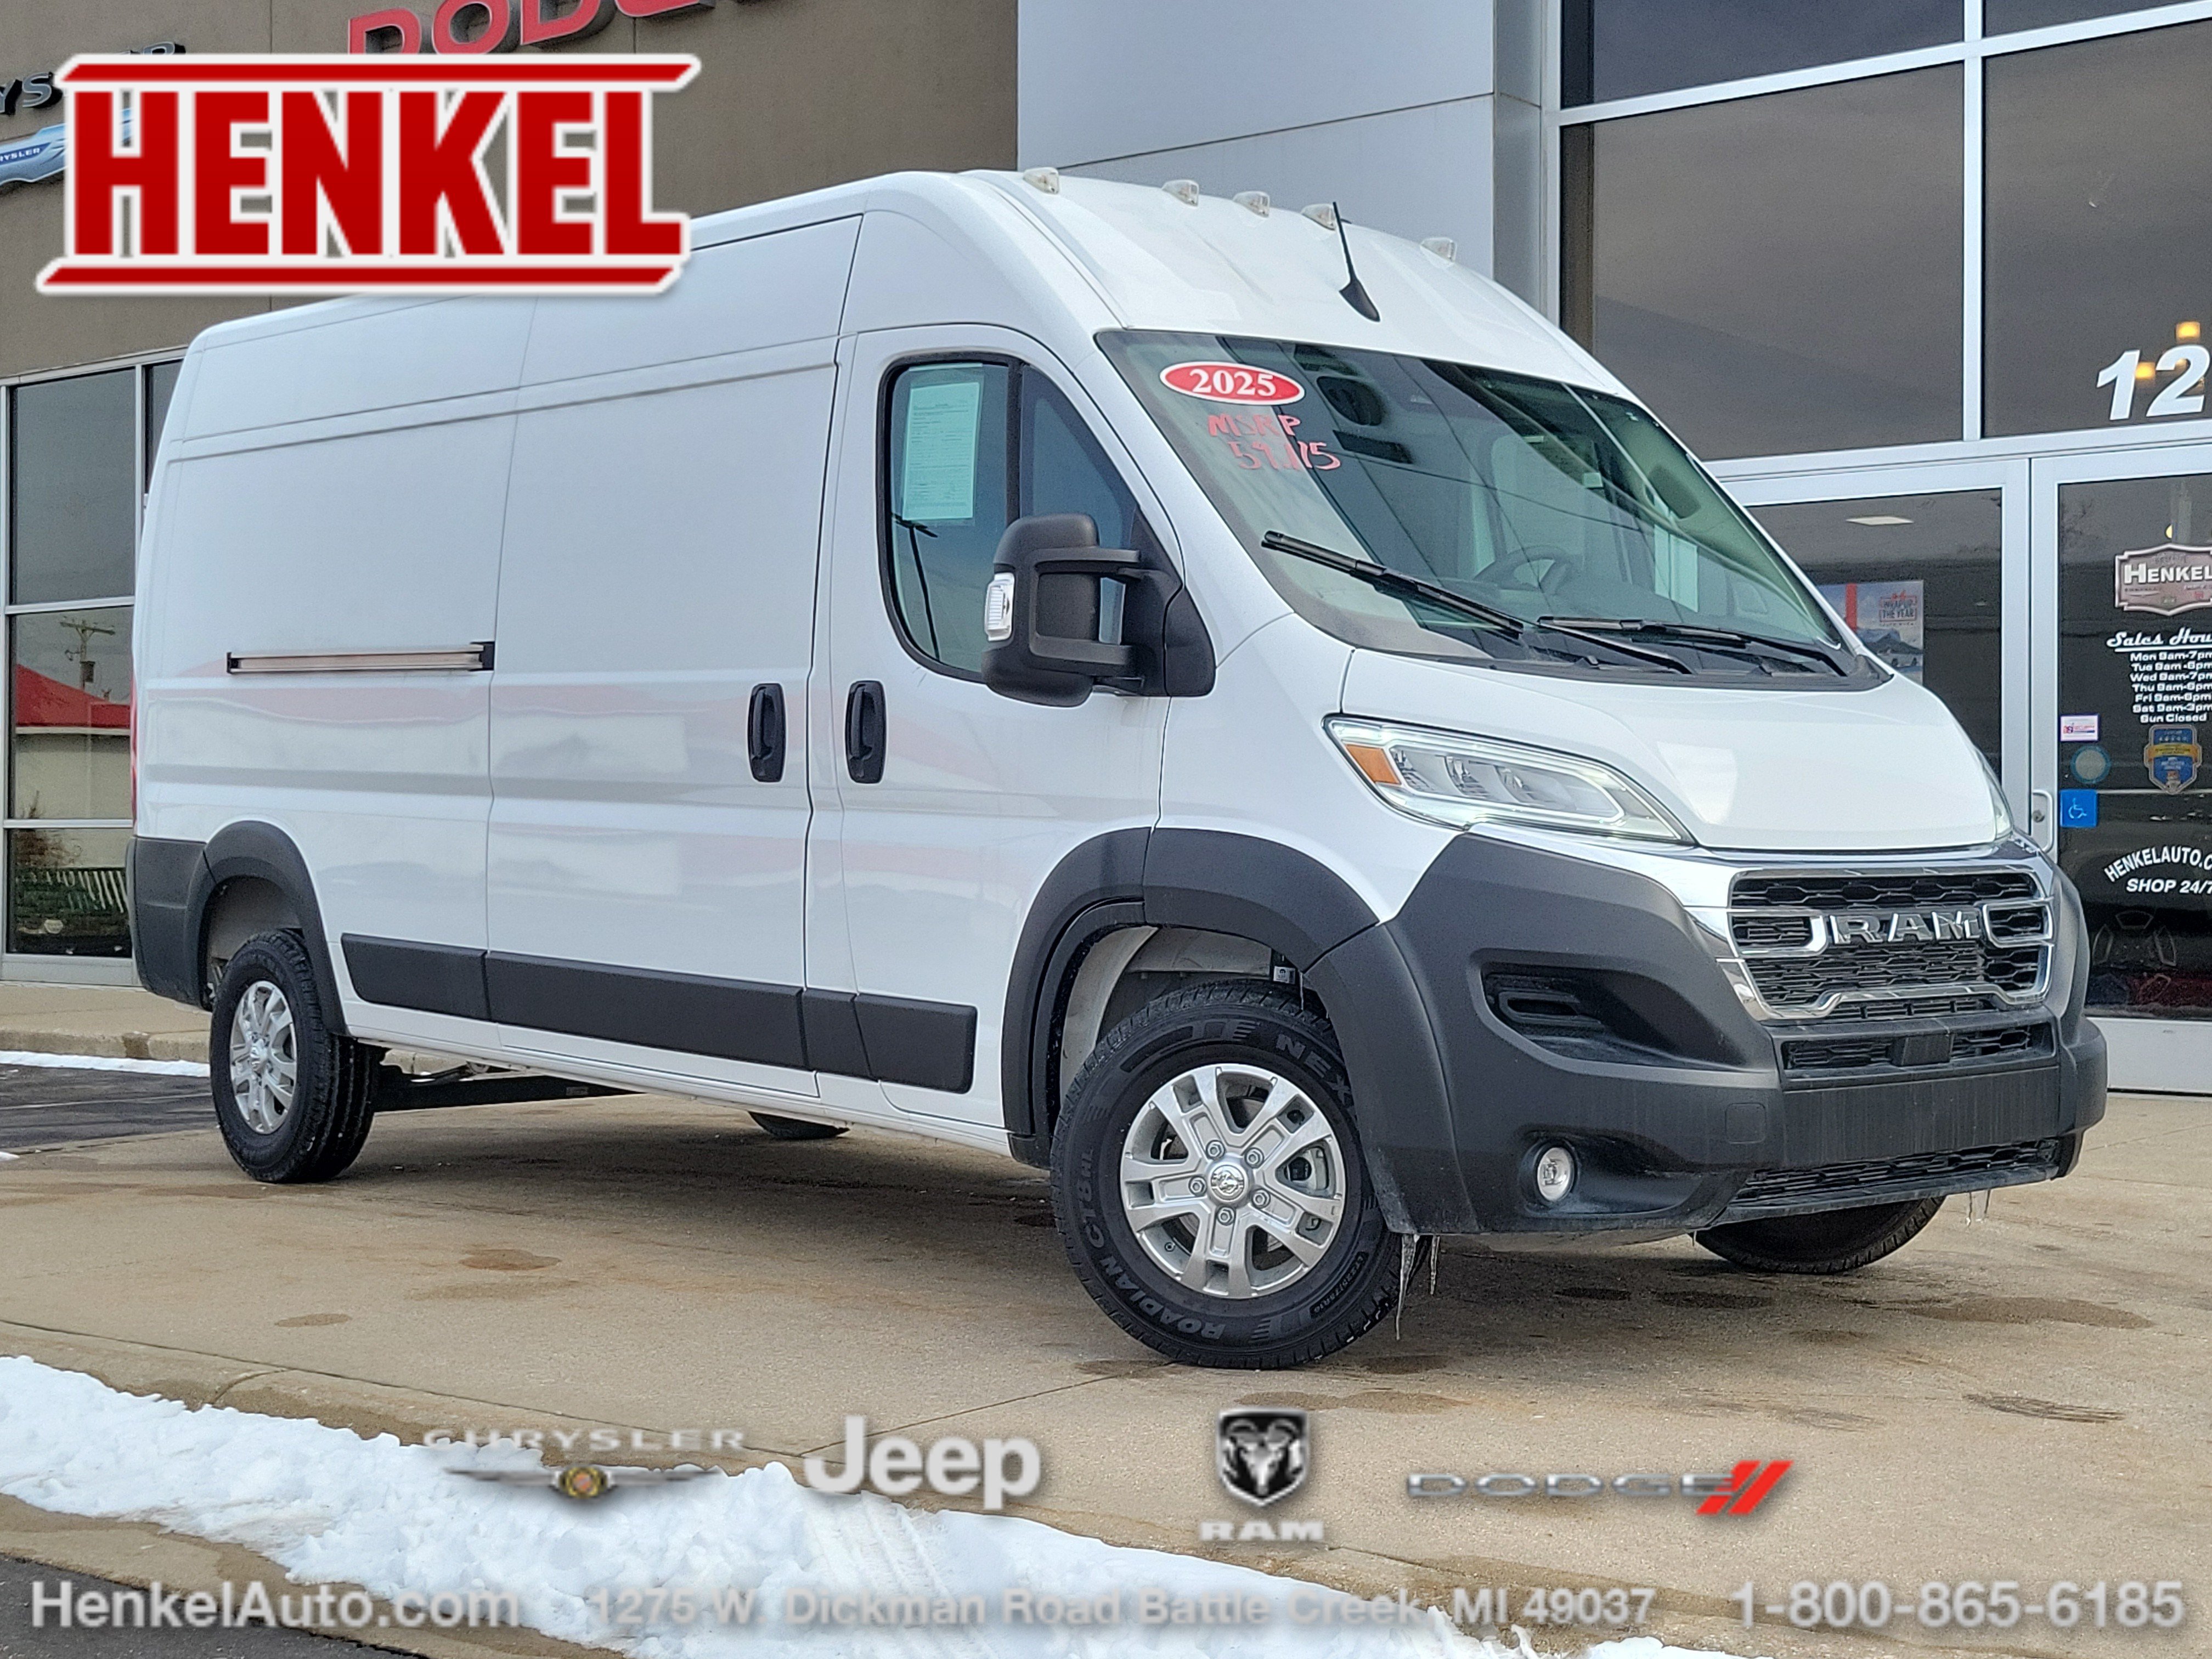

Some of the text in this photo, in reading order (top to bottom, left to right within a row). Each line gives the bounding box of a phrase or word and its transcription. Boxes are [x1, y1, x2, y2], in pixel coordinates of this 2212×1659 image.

[1189, 368, 1277, 397] 2025
[2097, 344, 2210, 421] 12
[1208, 414, 1301, 437] MSRP
[2124, 562, 2212, 584] HENKEL
[2106, 631, 2164, 647] Sales
[2130, 653, 2157, 662] Mon
[2131, 663, 2153, 672] Tue
[2130, 673, 2157, 682] Wed
[2132, 684, 2155, 692] Thu
[2135, 693, 2152, 702] Fri
[2132, 704, 2154, 713] Sat
[2140, 713, 2207, 723] Sun Closed
[2126, 878, 2177, 893] SHOP
[1829, 910, 1982, 944] RAM
[1099, 1256, 1227, 1340] ROADIAN
